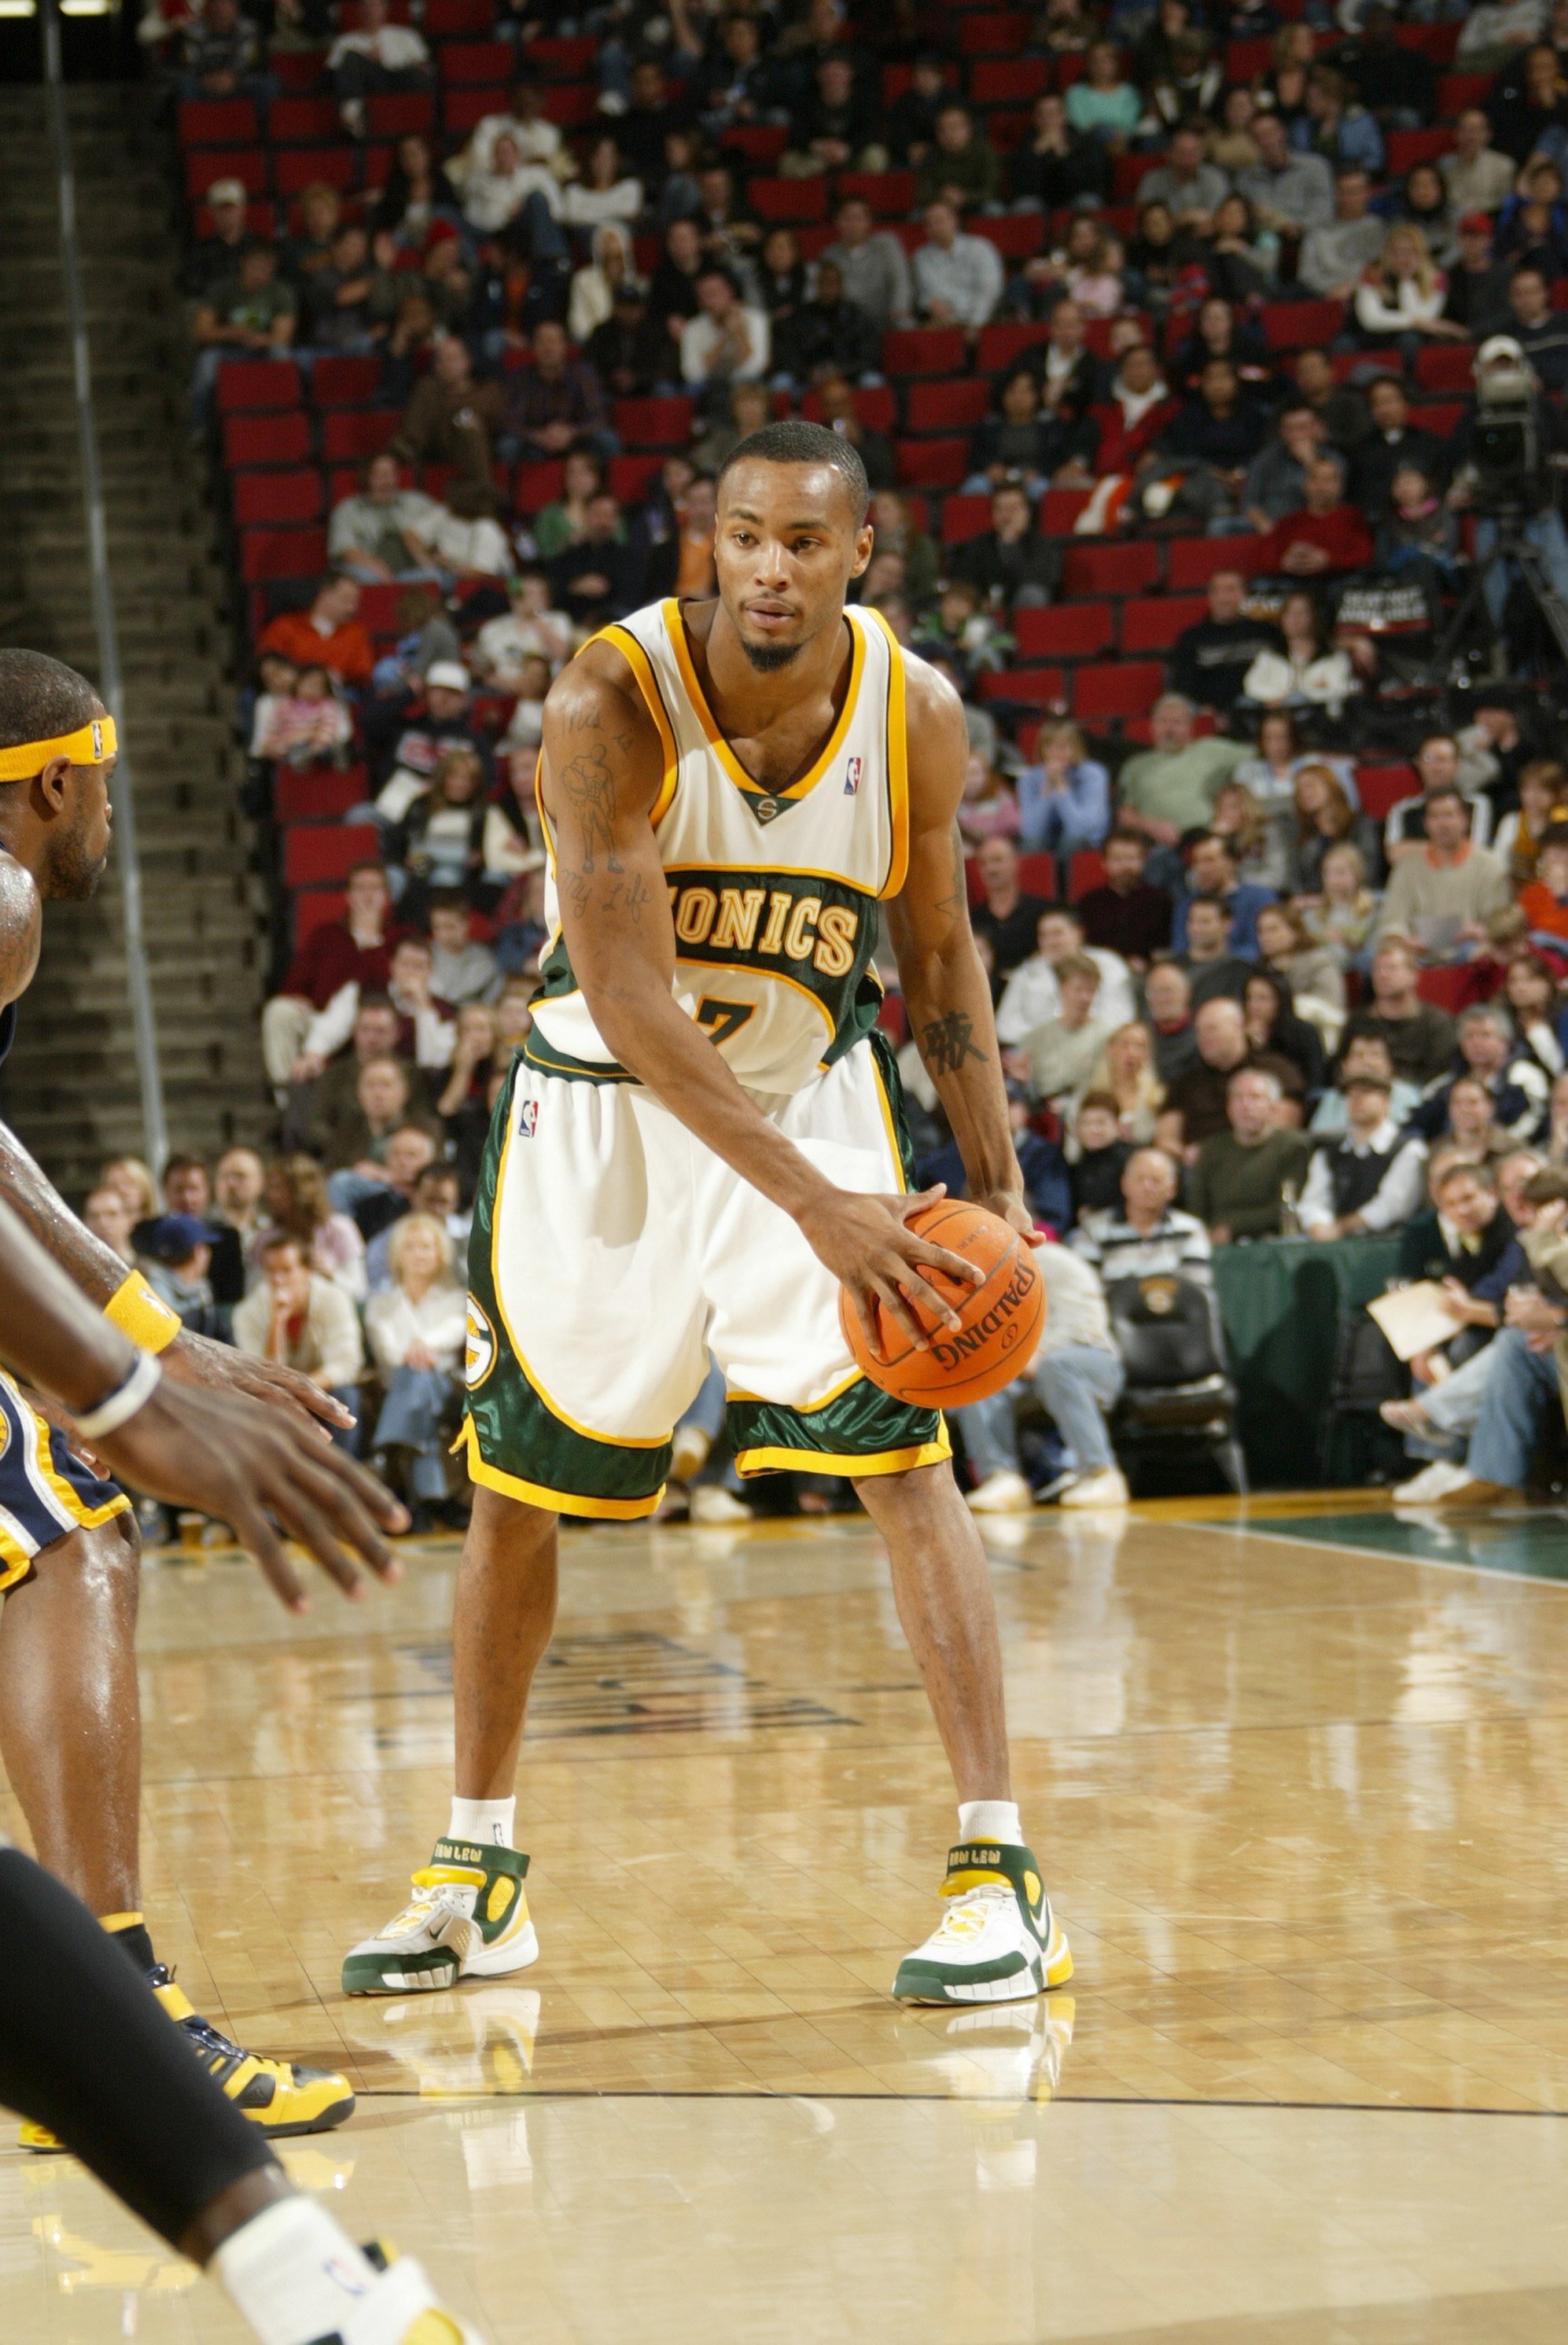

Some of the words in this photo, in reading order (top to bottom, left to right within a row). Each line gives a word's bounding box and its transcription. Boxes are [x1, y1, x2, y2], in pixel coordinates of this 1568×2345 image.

[602, 873, 651, 923] Life
[668, 885, 858, 977] ONICS
[693, 994, 757, 1047] 7
[931, 1252, 1036, 1372] SPALDING
